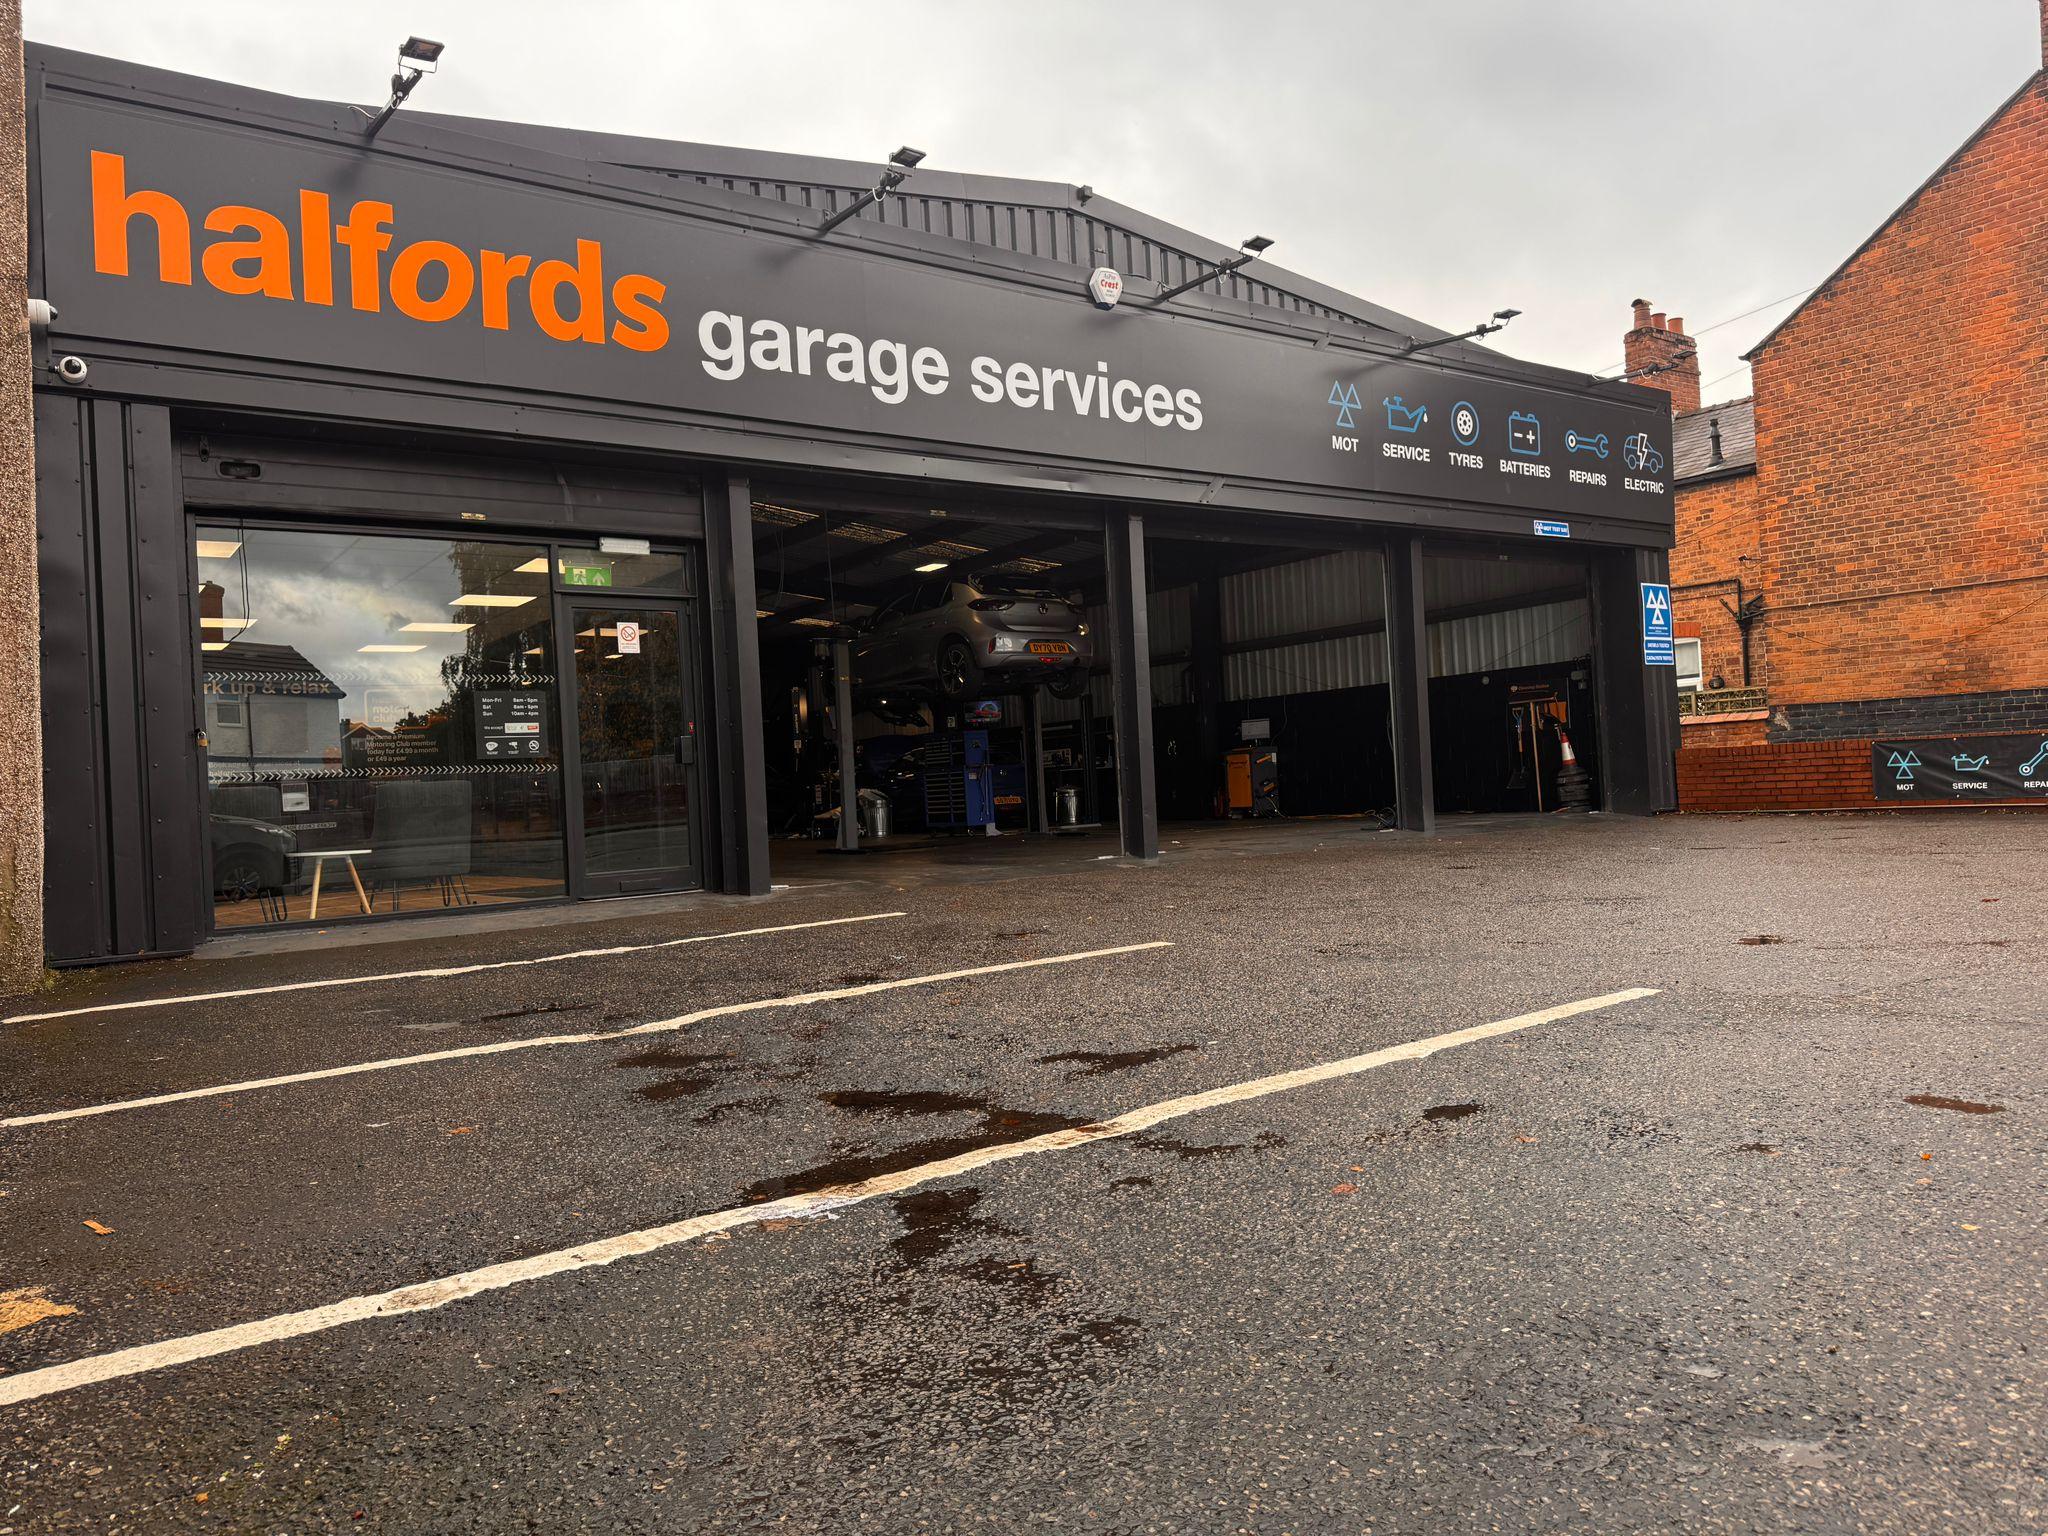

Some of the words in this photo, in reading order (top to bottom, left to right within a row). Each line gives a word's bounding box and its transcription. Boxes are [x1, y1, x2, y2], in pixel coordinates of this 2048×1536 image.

[90, 150, 671, 353] halfords
[1101, 279, 1119, 289] Crest
[698, 310, 950, 405] garage
[970, 356, 1204, 431] services
[1331, 434, 1359, 453] MOT
[1382, 442, 1431, 463] SERVICE
[1448, 451, 1484, 470] TYRES
[1499, 459, 1551, 479] BATTERIES
[1569, 469, 1607, 487] REPAIRS
[1624, 477, 1665, 494] ELECTRIC
[230, 681, 257, 698] up
[262, 680, 276, 694] &
[282, 680, 331, 694] relax
[396, 740, 411, 748] Club
[1896, 783, 1915, 791] MOT
[1952, 782, 1988, 790] SERVICE
